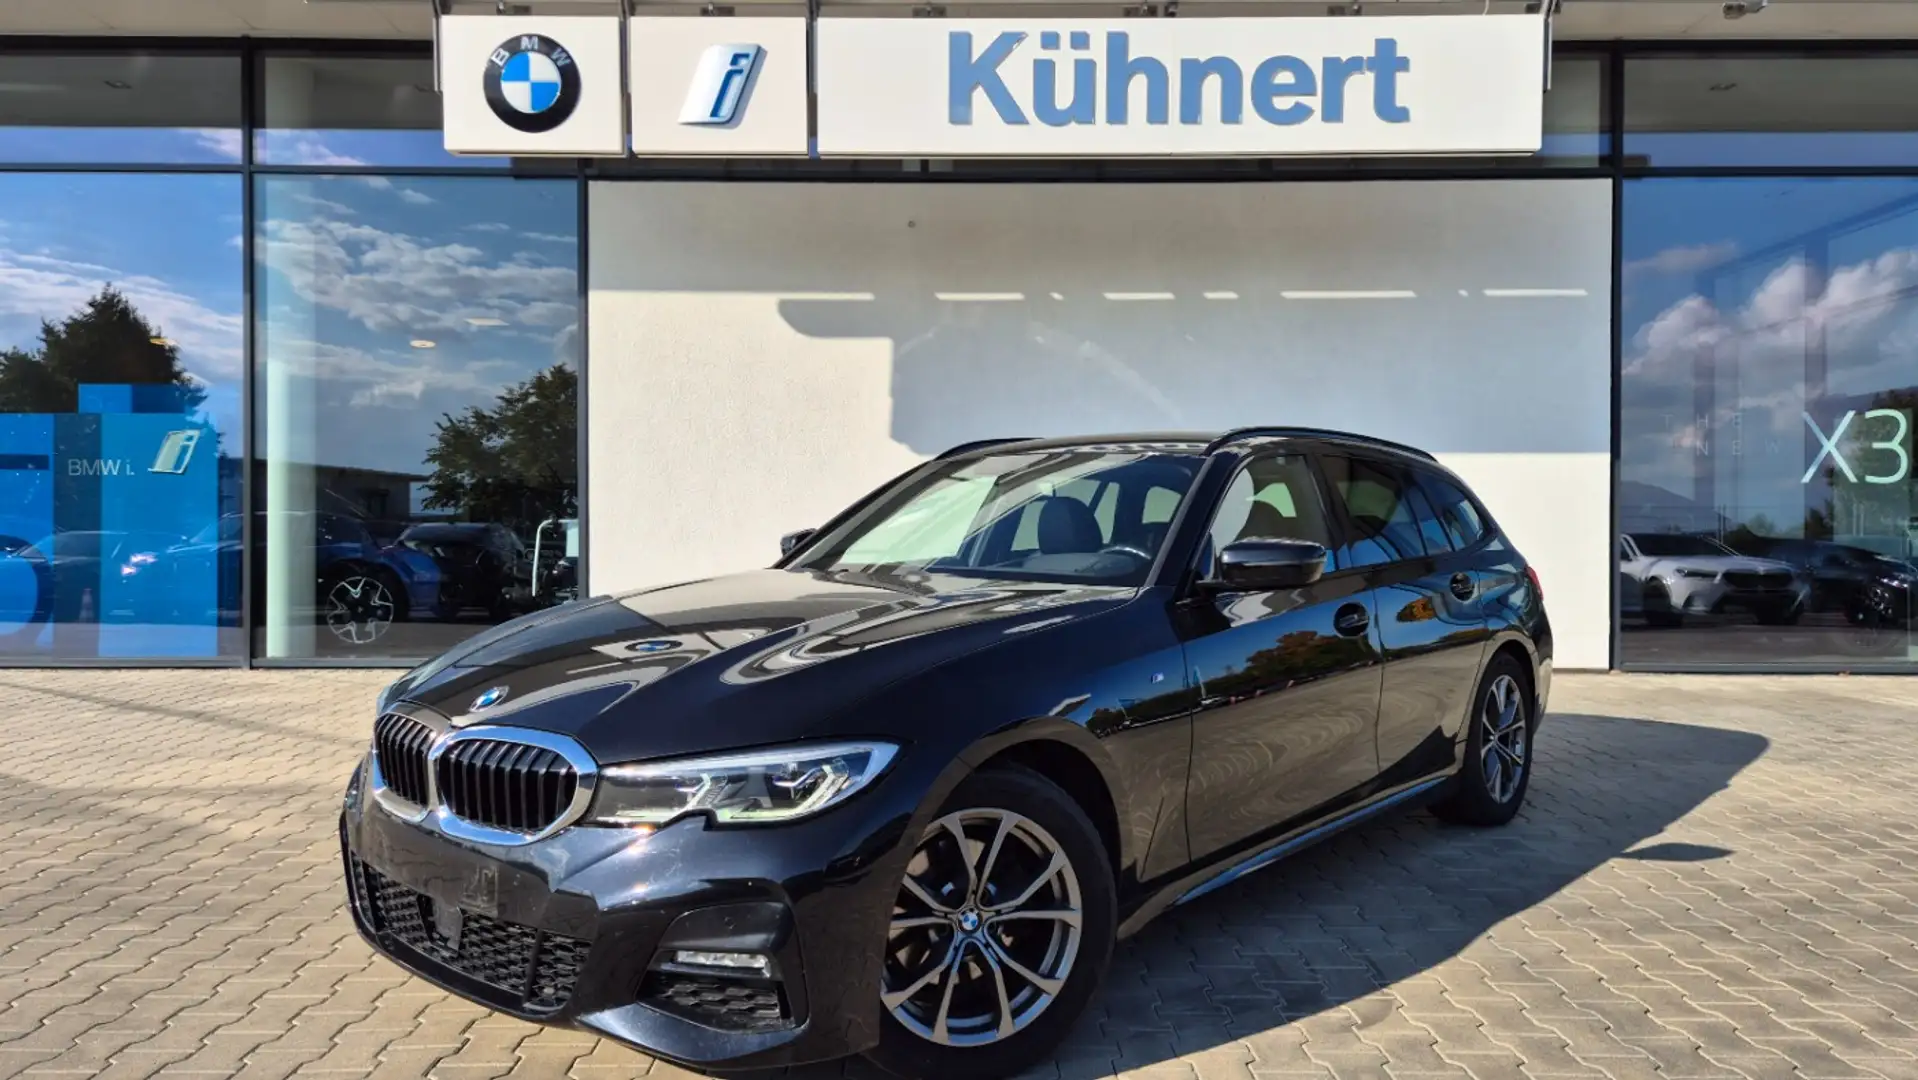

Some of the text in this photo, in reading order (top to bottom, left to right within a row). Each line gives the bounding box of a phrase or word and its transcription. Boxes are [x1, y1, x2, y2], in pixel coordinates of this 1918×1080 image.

[490, 35, 571, 67] BMW
[948, 31, 1411, 127] Kühnert
[1660, 413, 1742, 429] THE
[1696, 439, 1782, 456] NEW
[1800, 408, 1909, 484] X3
[68, 459, 121, 476] BMW
